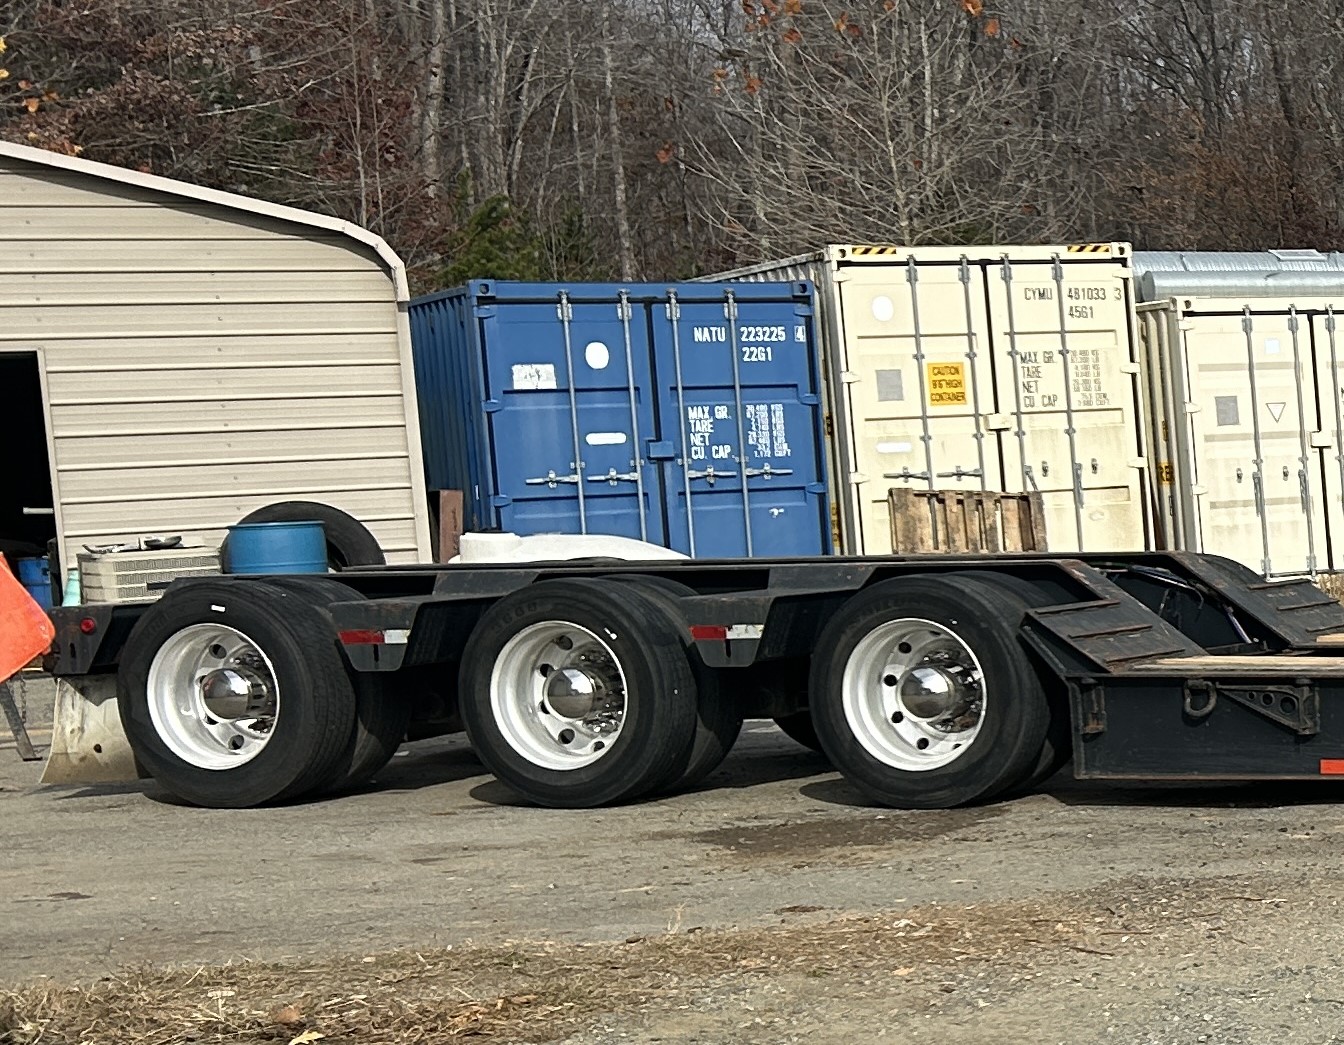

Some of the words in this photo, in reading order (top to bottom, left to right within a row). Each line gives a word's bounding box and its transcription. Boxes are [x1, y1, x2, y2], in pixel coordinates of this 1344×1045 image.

[1024, 287, 1053, 300] CYMU
[1067, 287, 1106, 300] 481033
[693, 327, 726, 342] NATU
[740, 326, 786, 342] 223225
[742, 347, 772, 361] 22G1
[1022, 380, 1038, 393] NET
[689, 419, 714, 433] TARE
[690, 433, 710, 446] NET
